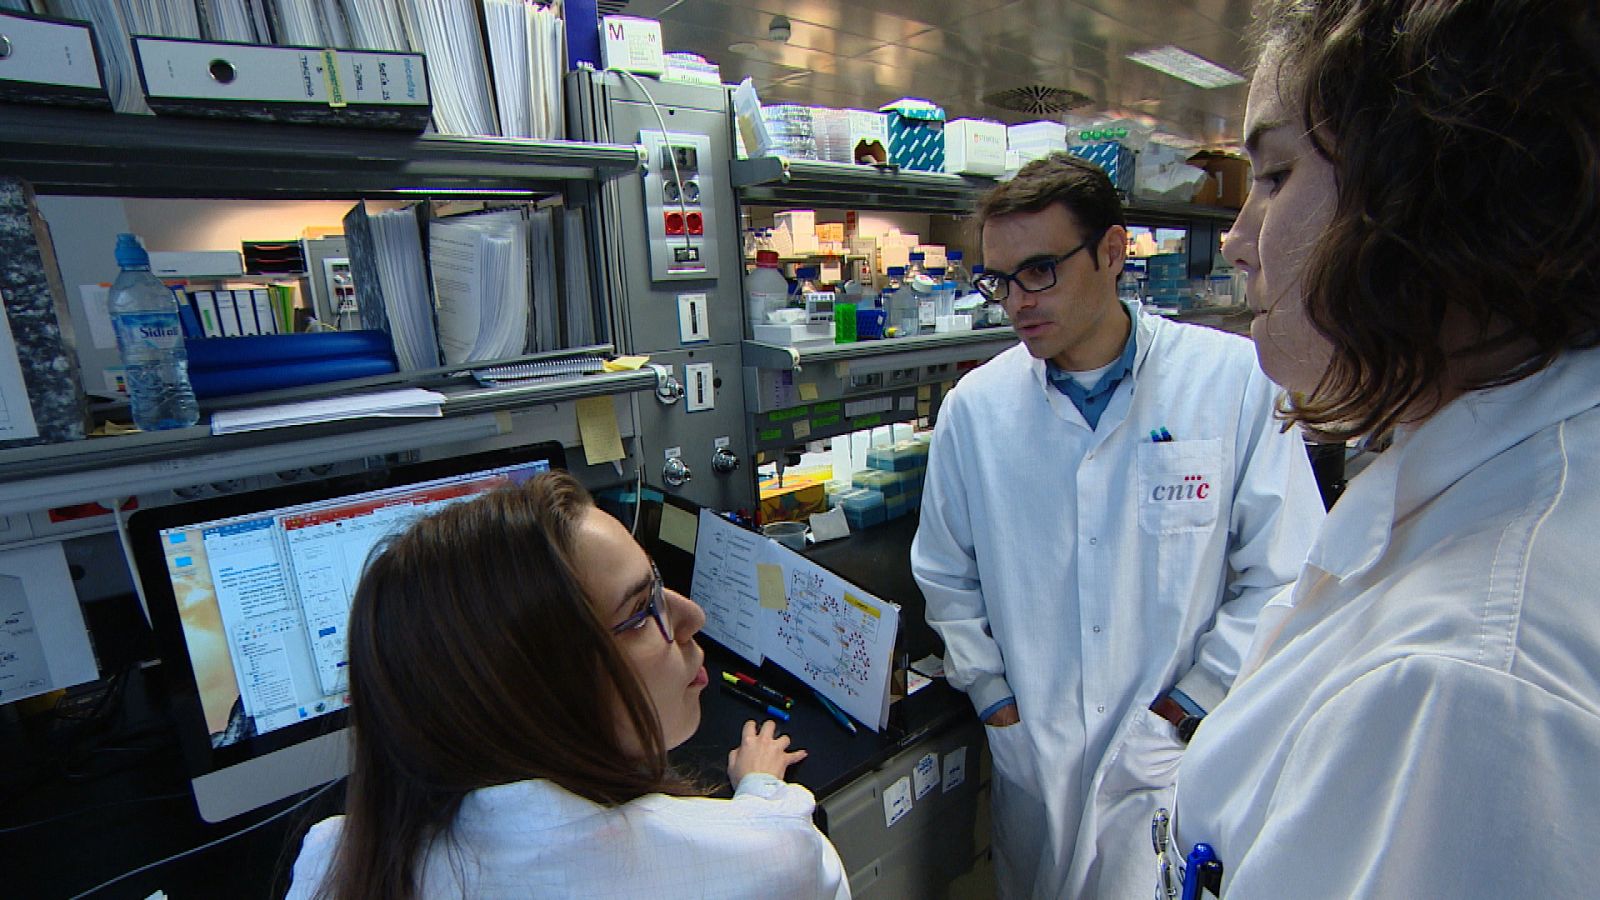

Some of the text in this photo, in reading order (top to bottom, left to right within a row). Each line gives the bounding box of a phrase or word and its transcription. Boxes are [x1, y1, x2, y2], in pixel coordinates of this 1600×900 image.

[608, 23, 625, 41] M
[403, 58, 416, 99] niceday
[1152, 475, 1210, 501] cnic
